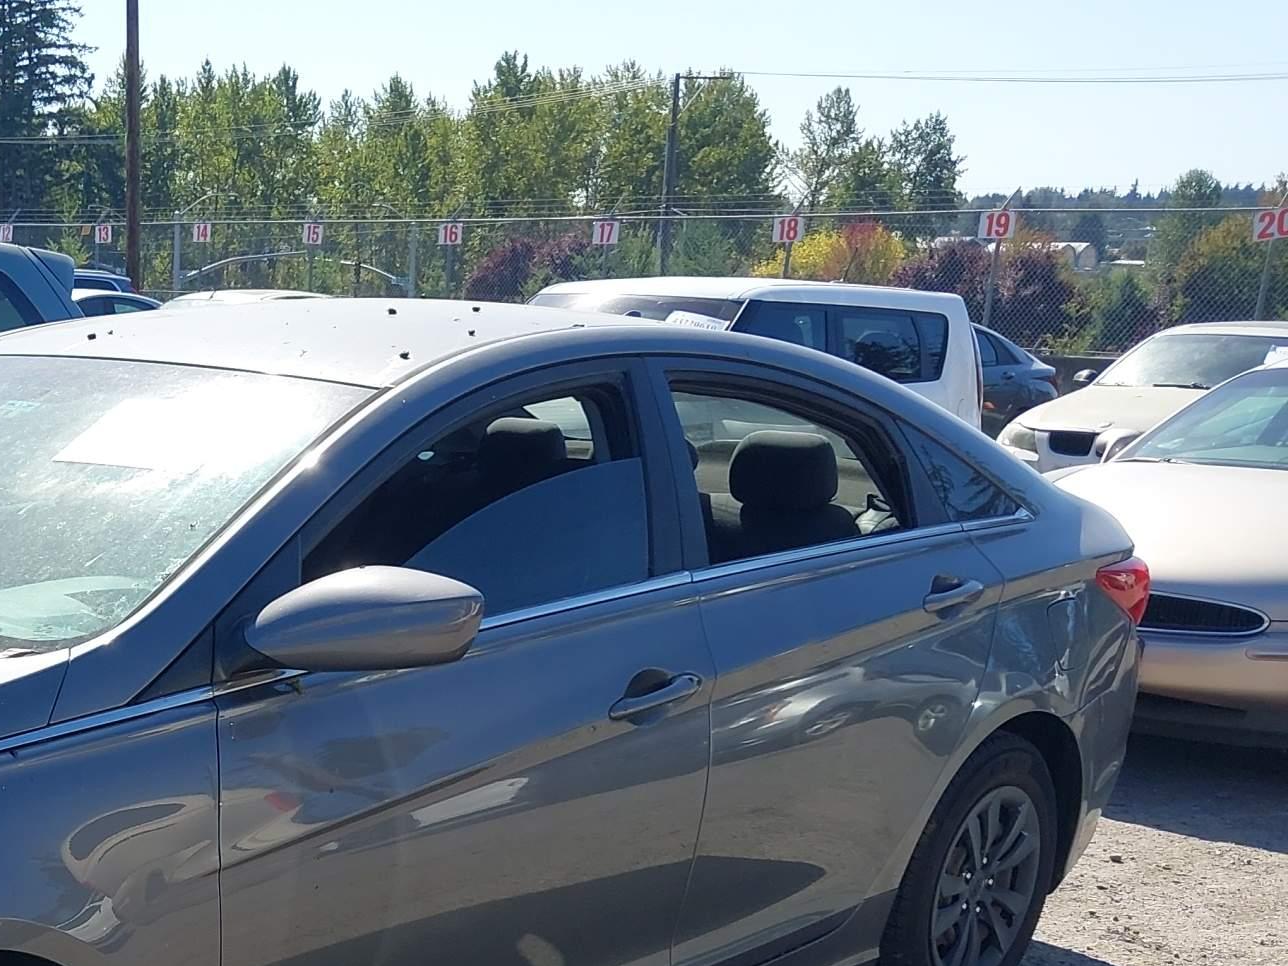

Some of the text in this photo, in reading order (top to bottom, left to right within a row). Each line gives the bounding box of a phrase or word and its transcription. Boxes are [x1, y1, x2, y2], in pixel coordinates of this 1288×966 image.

[196, 224, 208, 241] 14
[307, 225, 320, 242] 15
[599, 223, 615, 243] 17
[779, 218, 798, 240] 18
[986, 212, 1010, 237] 19
[1257, 209, 1288, 239] 20
[98, 226, 109, 242] 13
[443, 225, 458, 243] 16
